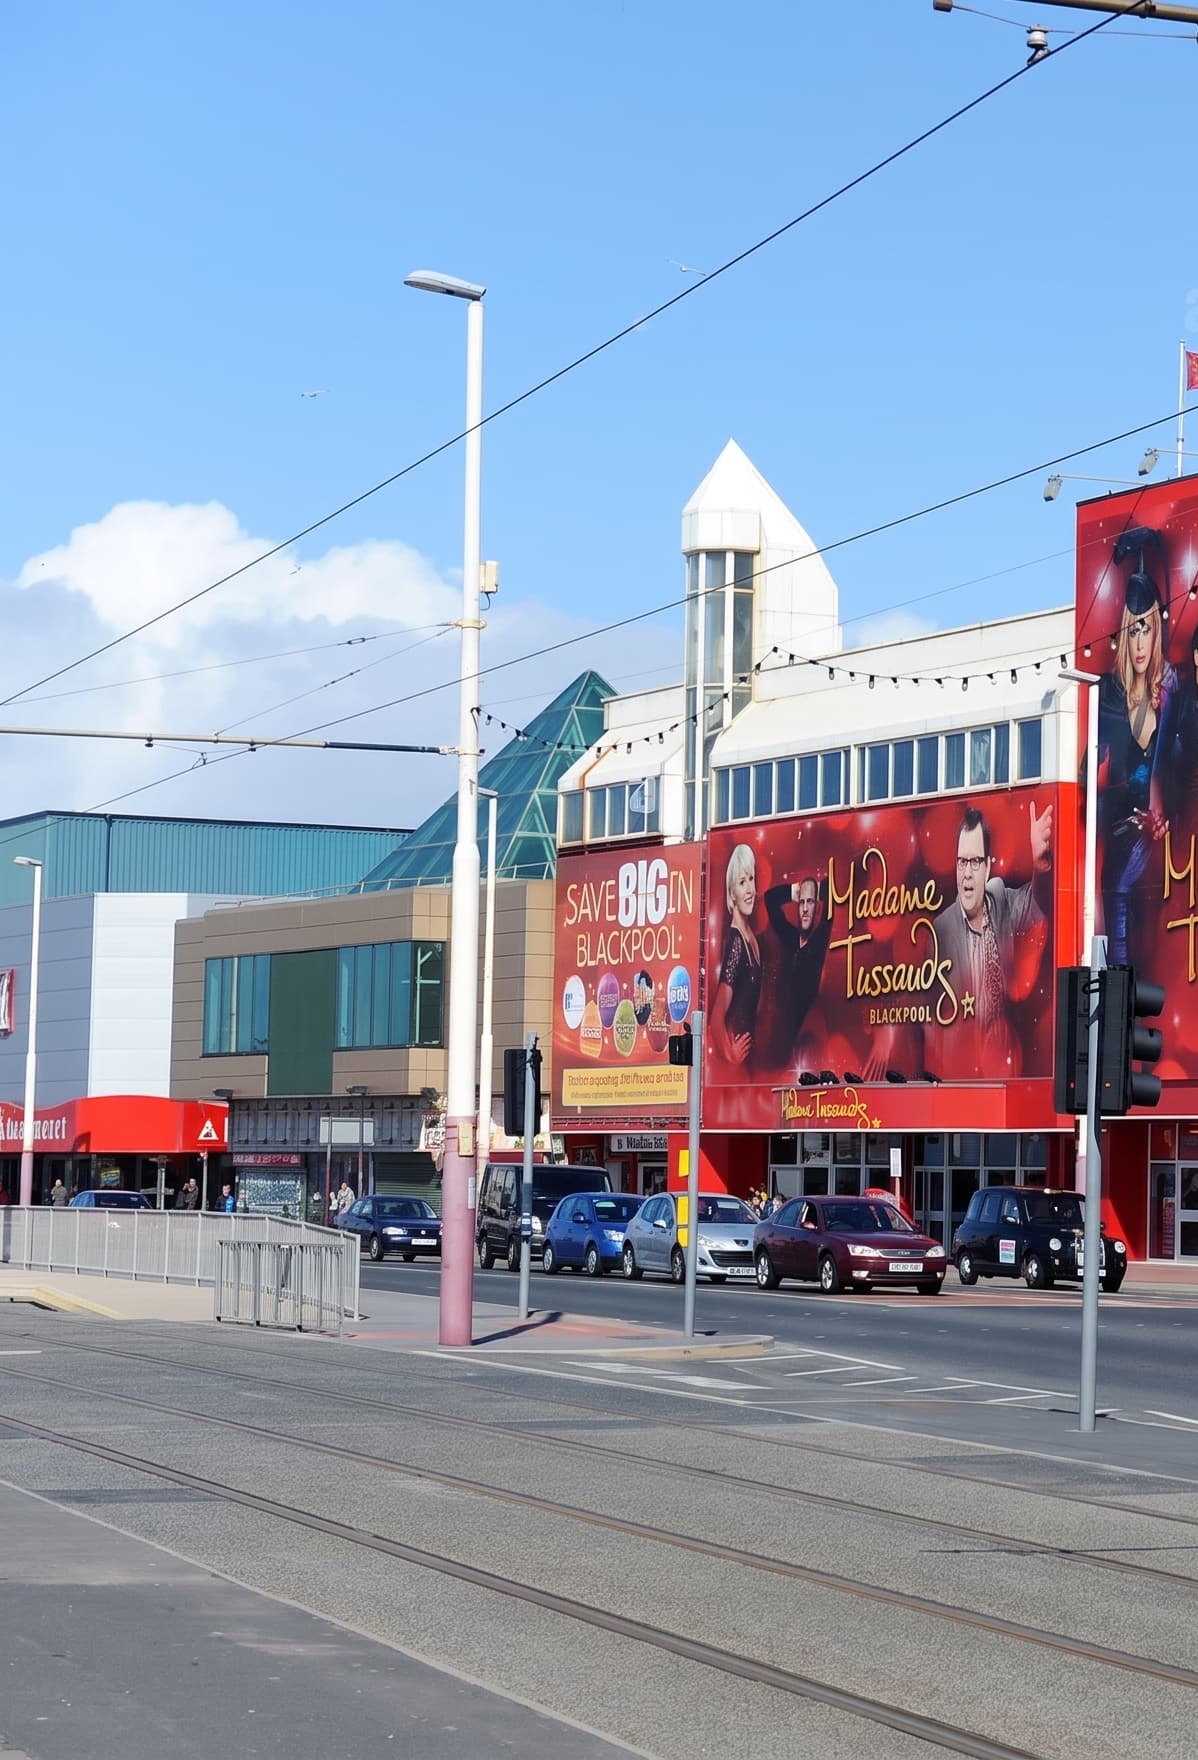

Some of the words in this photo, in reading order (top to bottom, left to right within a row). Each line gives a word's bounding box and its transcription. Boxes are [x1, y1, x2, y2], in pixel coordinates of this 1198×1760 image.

[564, 880, 617, 927] SAVE
[618, 859, 668, 927] BIG
[668, 870, 693, 913] IN
[827, 848, 943, 929] Madame
[577, 925, 680, 967] BLACKPOOL
[829, 918, 957, 1025] Tussauds
[869, 1005, 932, 1025] BLACKPOOL
